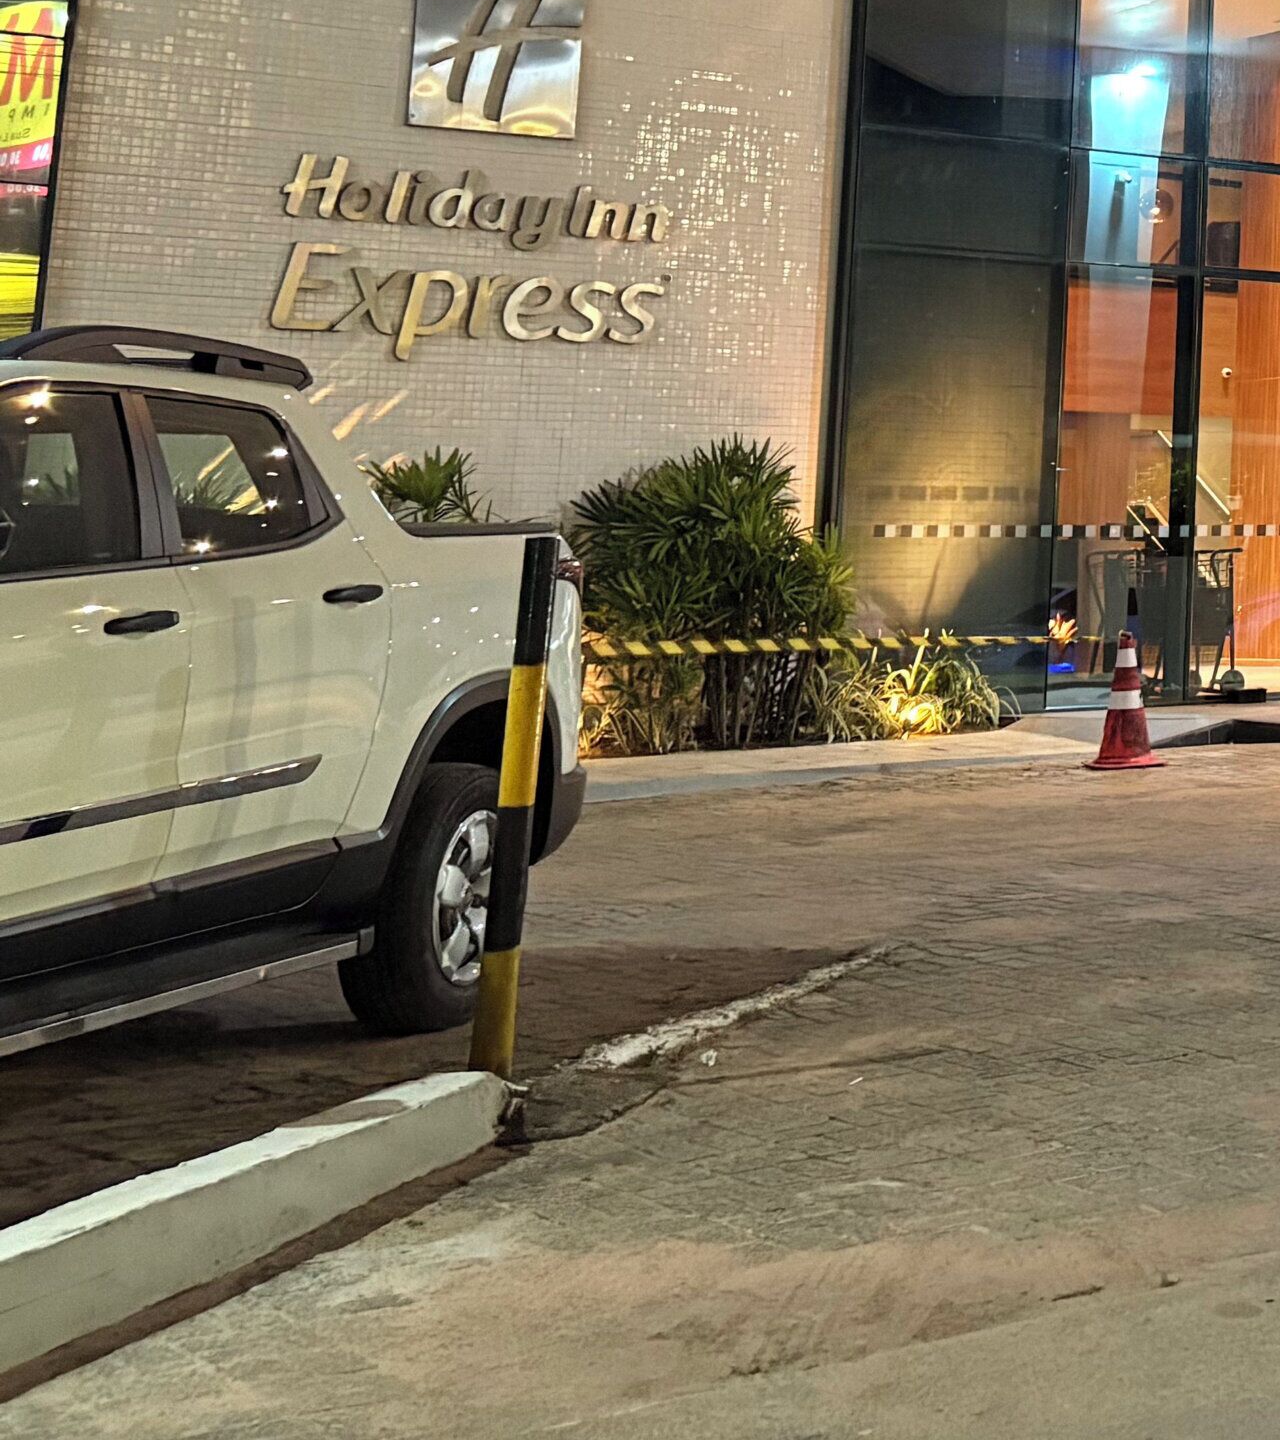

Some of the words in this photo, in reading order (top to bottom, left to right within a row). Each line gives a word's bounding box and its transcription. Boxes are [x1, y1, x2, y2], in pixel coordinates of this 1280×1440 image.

[282, 153, 564, 251] Holiday
[567, 185, 671, 243] Inn
[270, 241, 665, 360] Express
